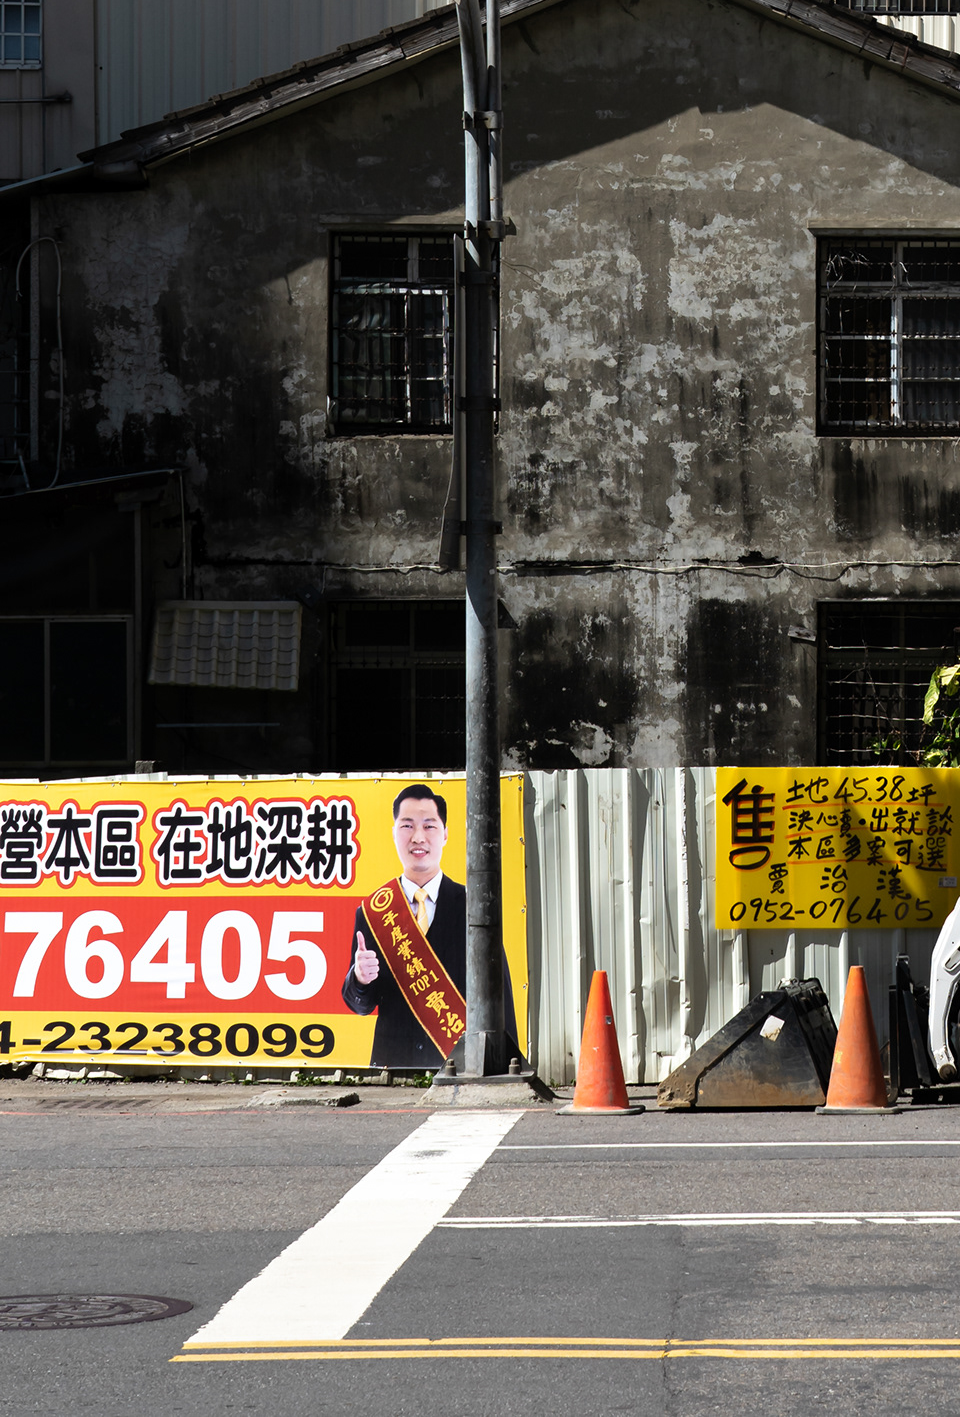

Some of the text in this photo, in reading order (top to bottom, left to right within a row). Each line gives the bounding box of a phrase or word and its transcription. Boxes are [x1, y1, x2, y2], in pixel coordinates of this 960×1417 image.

[0, 803, 354, 881] 營本區 在地深耕
[381, 909, 428, 978] 年度業績
[729, 896, 934, 924] 0952-076405
[2, 909, 328, 1001] 76405
[424, 990, 467, 1045] 賈治
